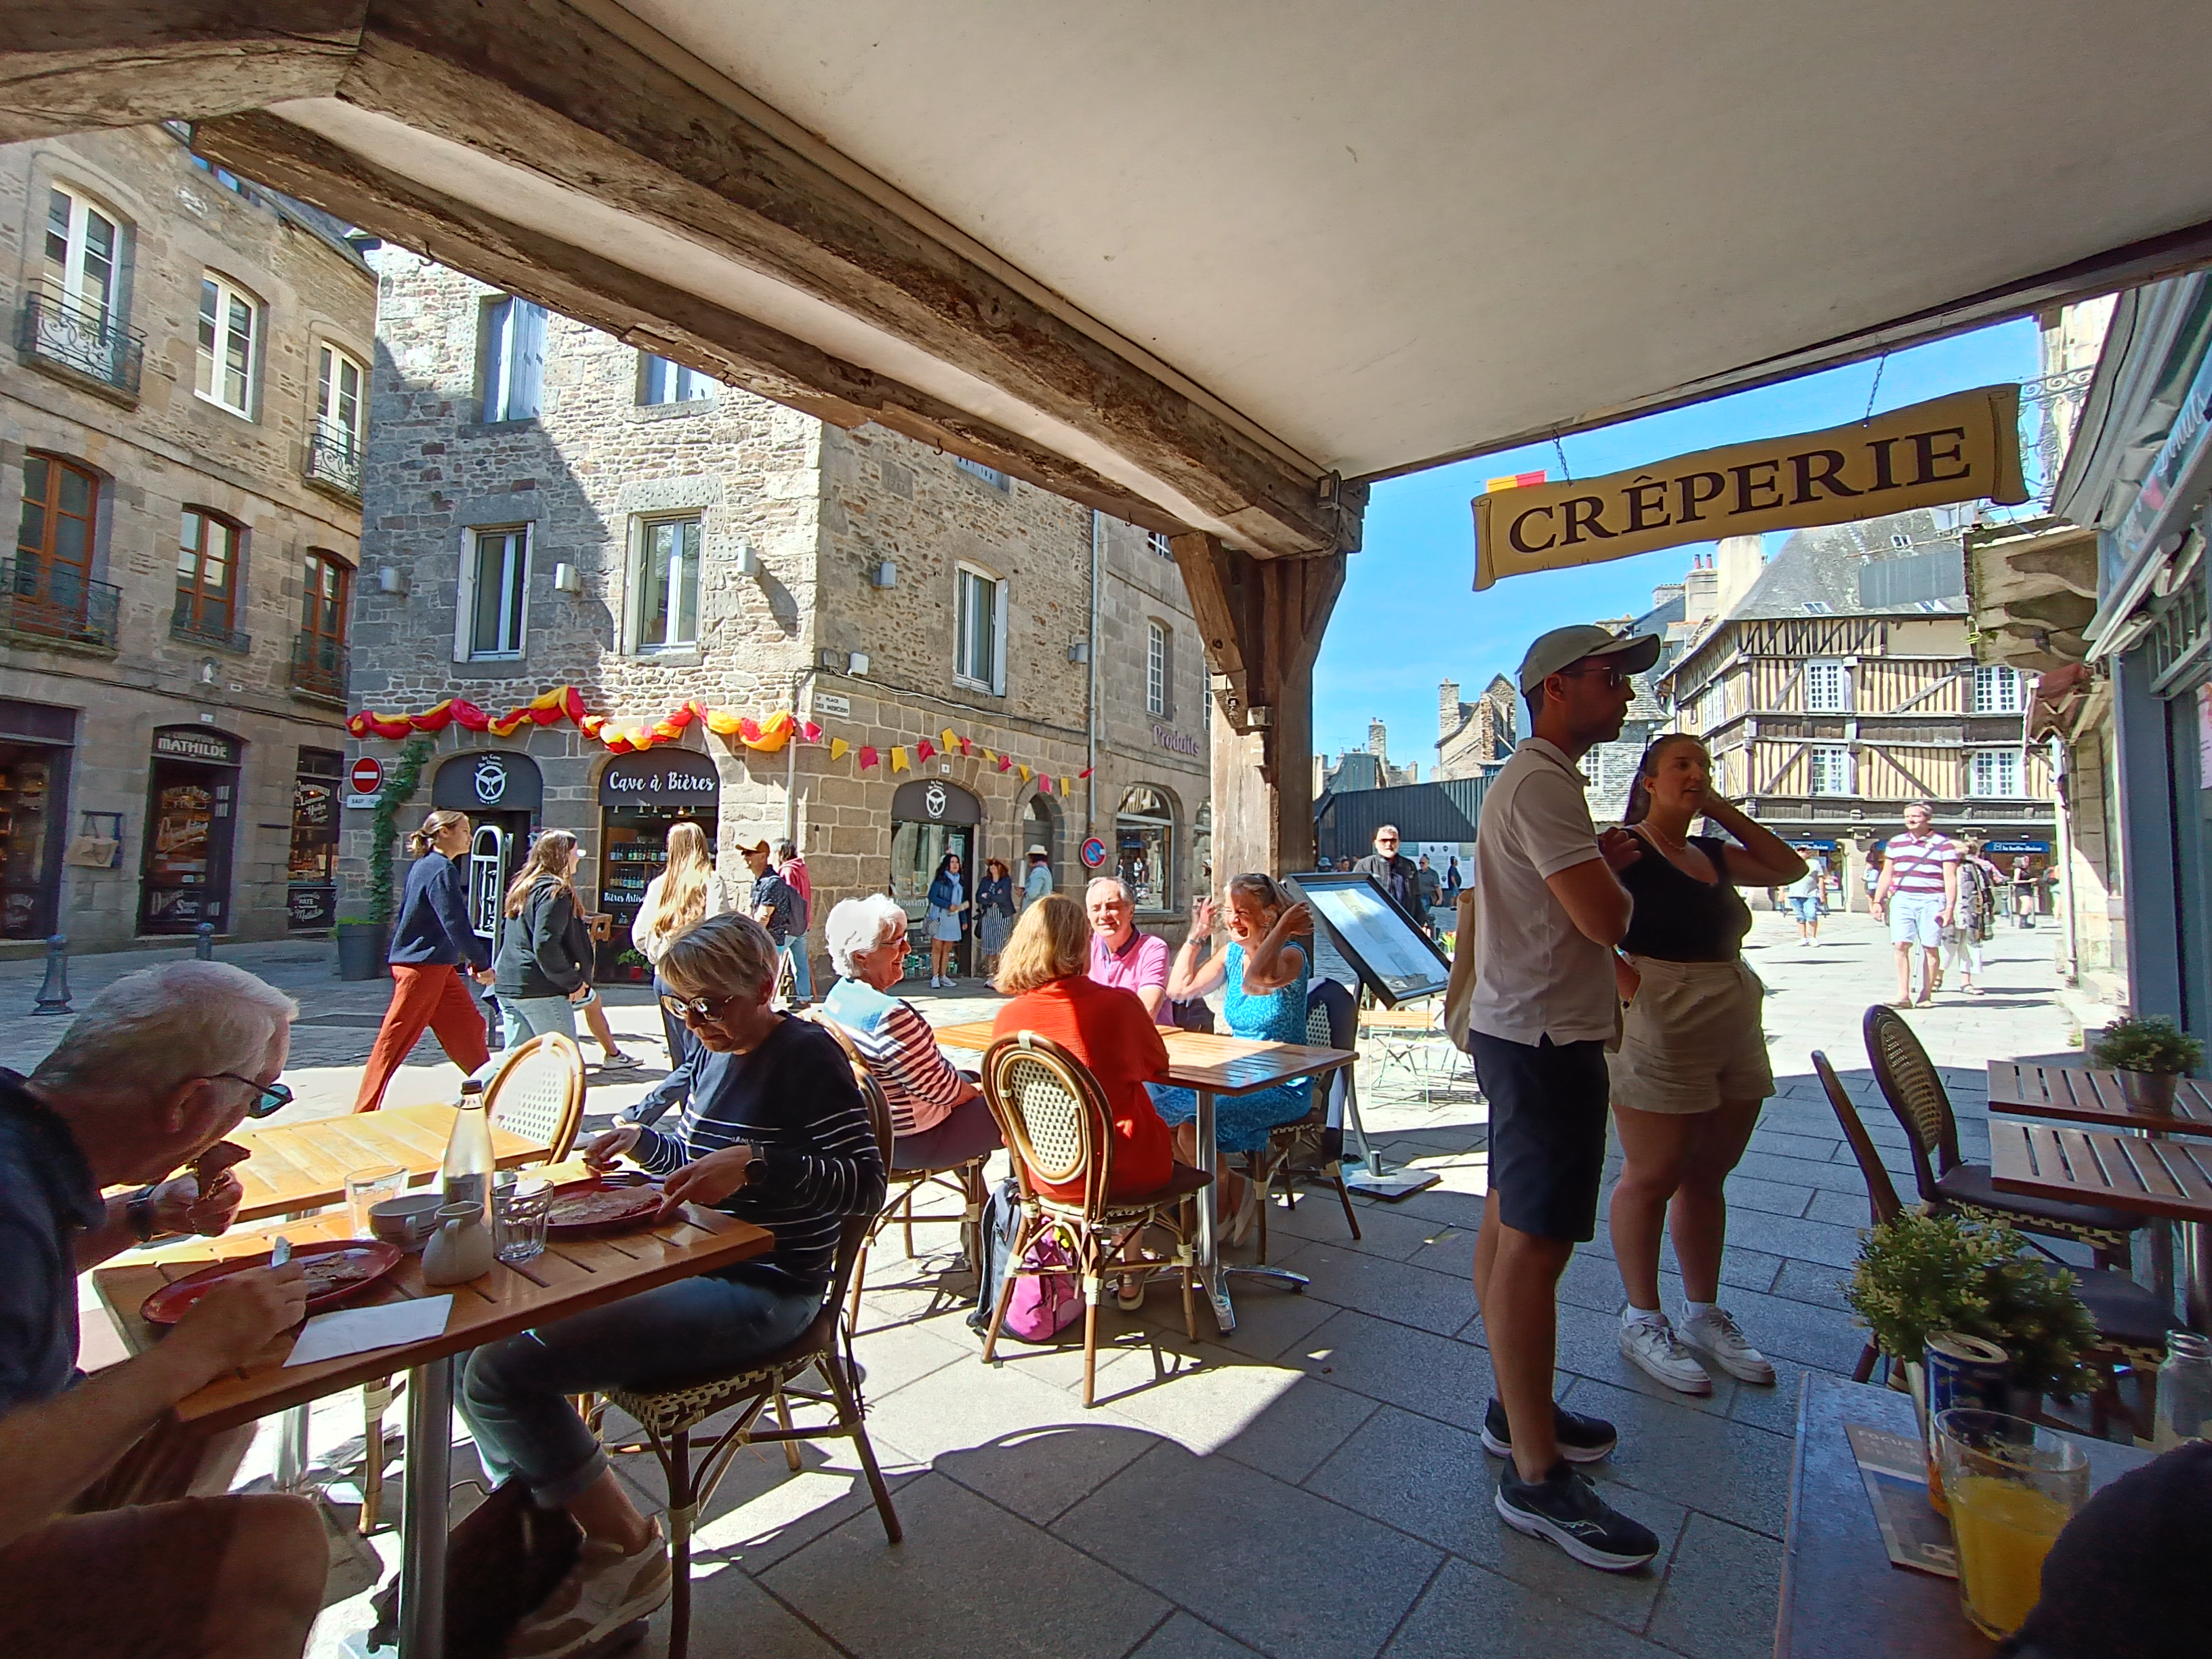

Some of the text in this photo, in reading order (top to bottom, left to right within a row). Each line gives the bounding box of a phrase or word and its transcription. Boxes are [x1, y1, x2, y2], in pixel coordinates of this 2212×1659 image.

[1509, 426, 1971, 554] CRÊPERIE
[157, 737, 228, 758] MATHILDE
[1153, 724, 1200, 758] Produits
[609, 771, 715, 792] Cave à Bières
